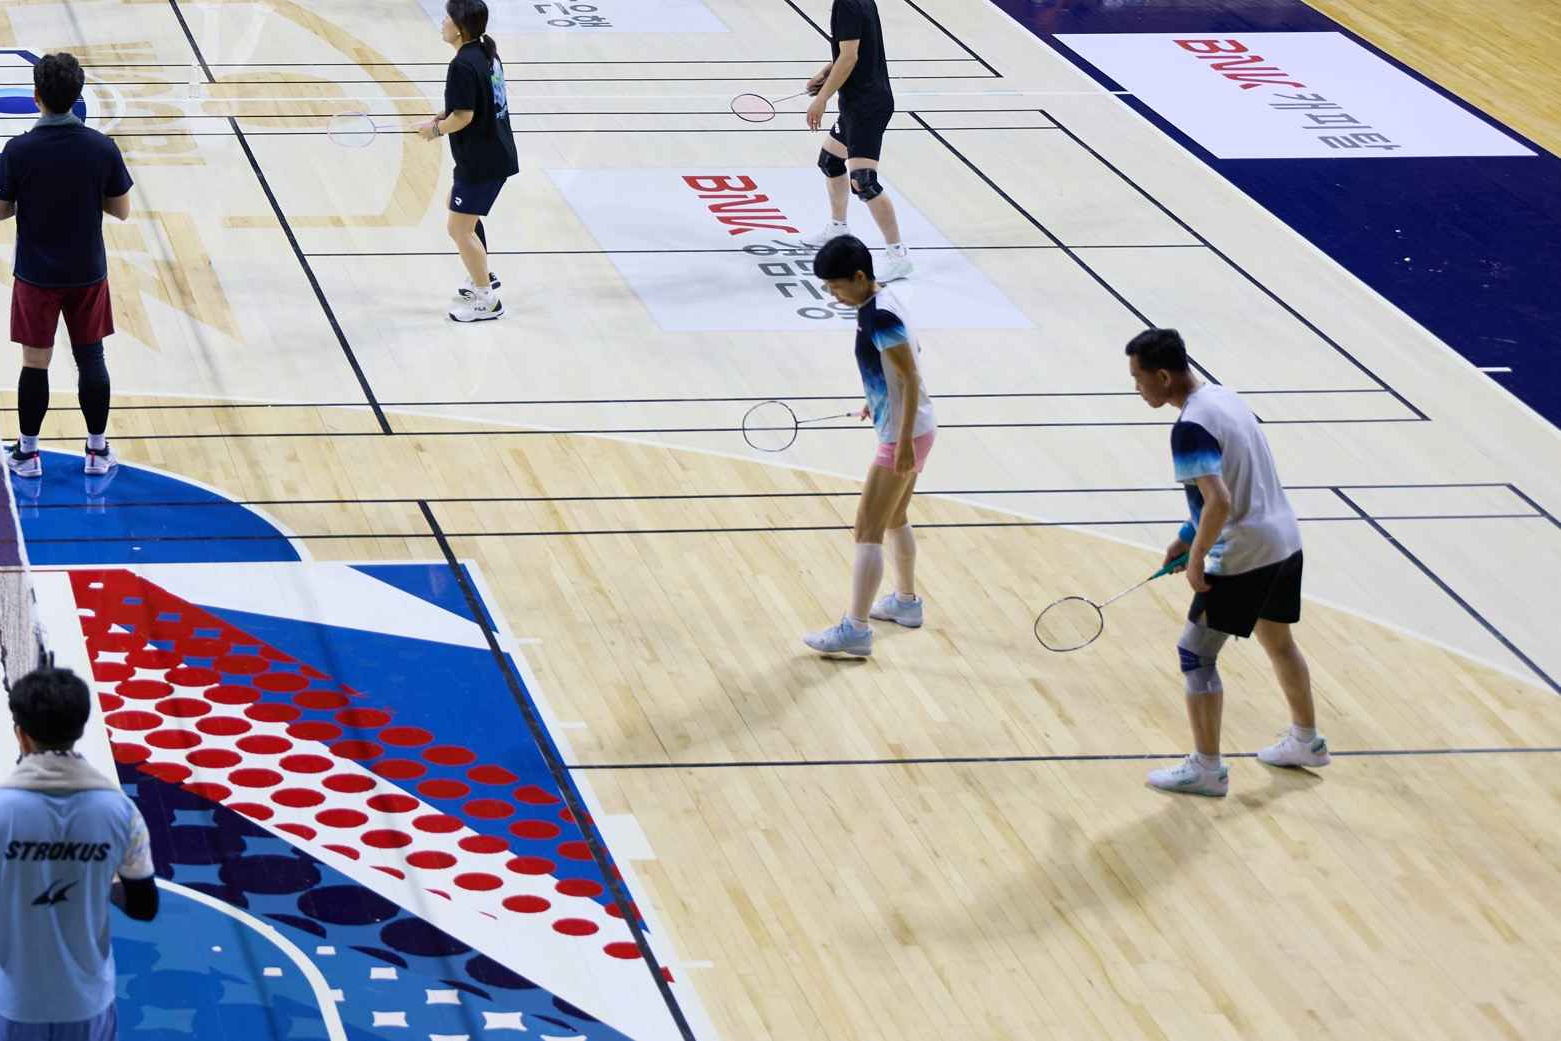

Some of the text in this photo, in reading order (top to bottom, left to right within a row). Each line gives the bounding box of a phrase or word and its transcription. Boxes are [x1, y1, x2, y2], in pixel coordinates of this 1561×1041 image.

[1172, 39, 1307, 90] BNK
[1268, 93, 1403, 150] 캐피탈
[681, 175, 801, 236] BNK
[4, 840, 112, 862] STROKUS
